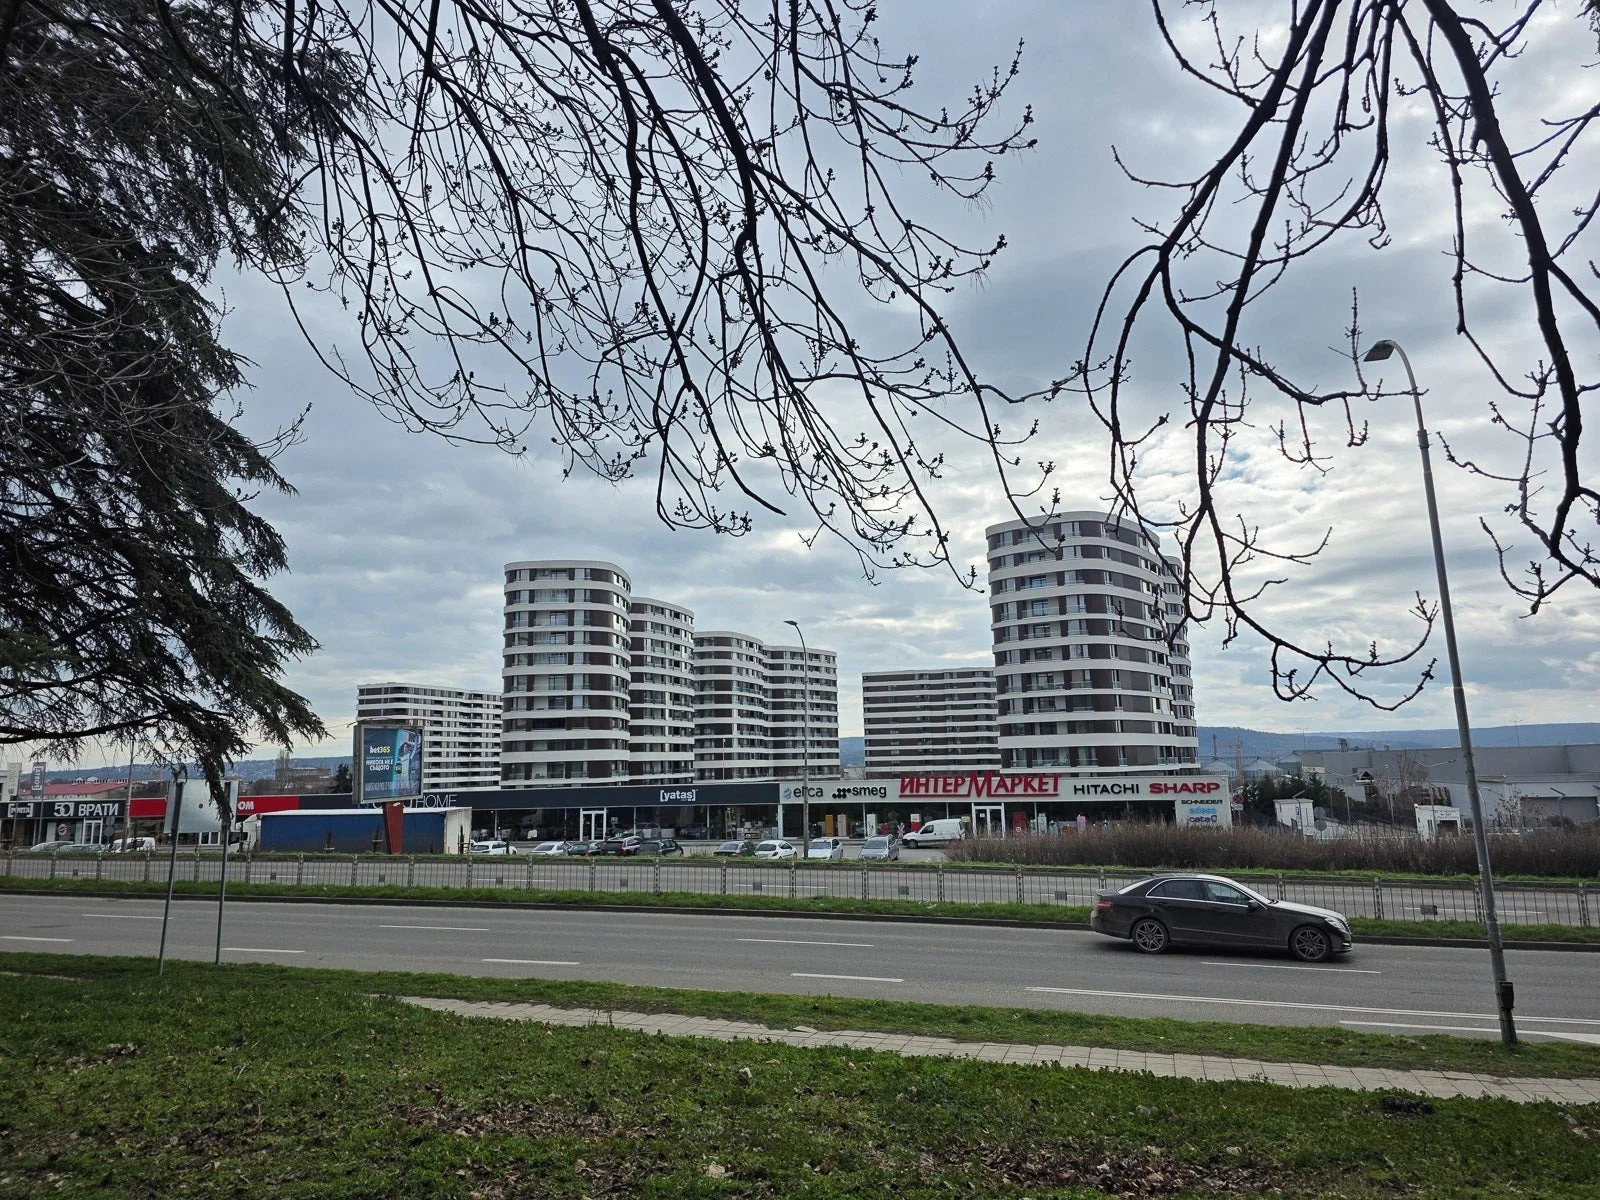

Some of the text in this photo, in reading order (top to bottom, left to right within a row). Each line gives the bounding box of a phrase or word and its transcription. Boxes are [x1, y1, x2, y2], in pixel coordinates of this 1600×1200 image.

[370, 745, 391, 754] bet365
[899, 771, 1062, 798] ИНТЕРМАРКЕТ
[1073, 783, 1140, 795] HITACHI
[1149, 782, 1220, 794] SHARP
[793, 786, 823, 798] elca
[852, 786, 887, 799] smeg
[415, 794, 458, 809] HOME
[78, 803, 119, 817] ВРАТИ
